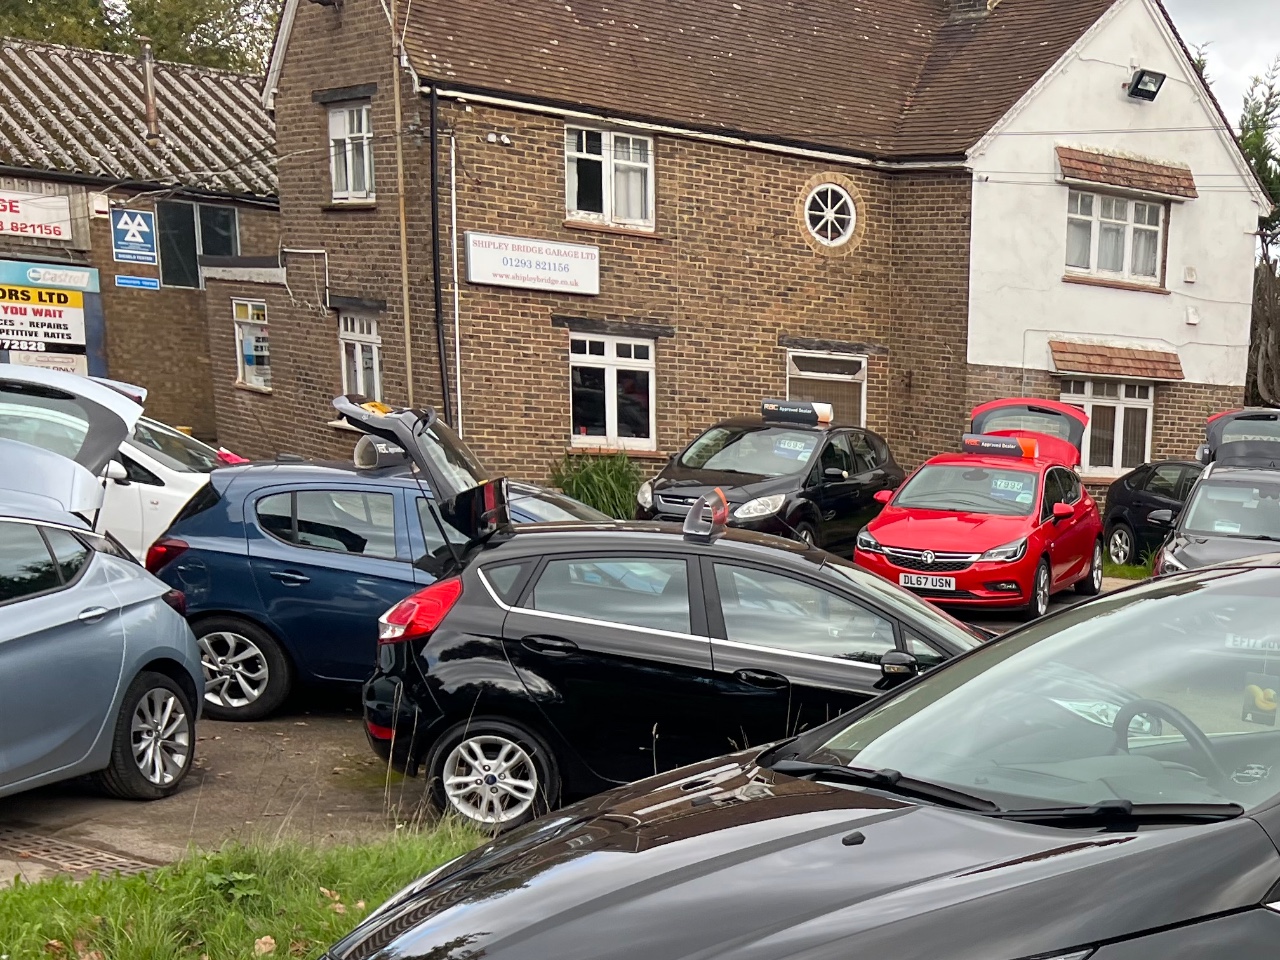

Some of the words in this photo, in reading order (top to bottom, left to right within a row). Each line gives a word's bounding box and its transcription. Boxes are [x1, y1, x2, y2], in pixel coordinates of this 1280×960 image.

[10, 222, 62, 236] 821156
[472, 239, 509, 251] SHIPLEY
[511, 244, 543, 255] BRIDGE
[545, 248, 579, 259] GARAGE
[581, 252, 596, 261] LTD
[502, 257, 532, 269] 01293
[535, 261, 570, 273] 821156
[42, 270, 85, 284] Castrol
[492, 271, 579, 287] www.shipleybridge.co.uk
[37, 291, 69, 304] LTD
[1, 305, 27, 316] YOU
[32, 307, 64, 318] WAIT
[29, 321, 69, 330] REPAIRS
[44, 332, 72, 340] RATES
[0, 339, 45, 351] 72828
[903, 574, 929, 586] DL67
[931, 577, 951, 588] USN
